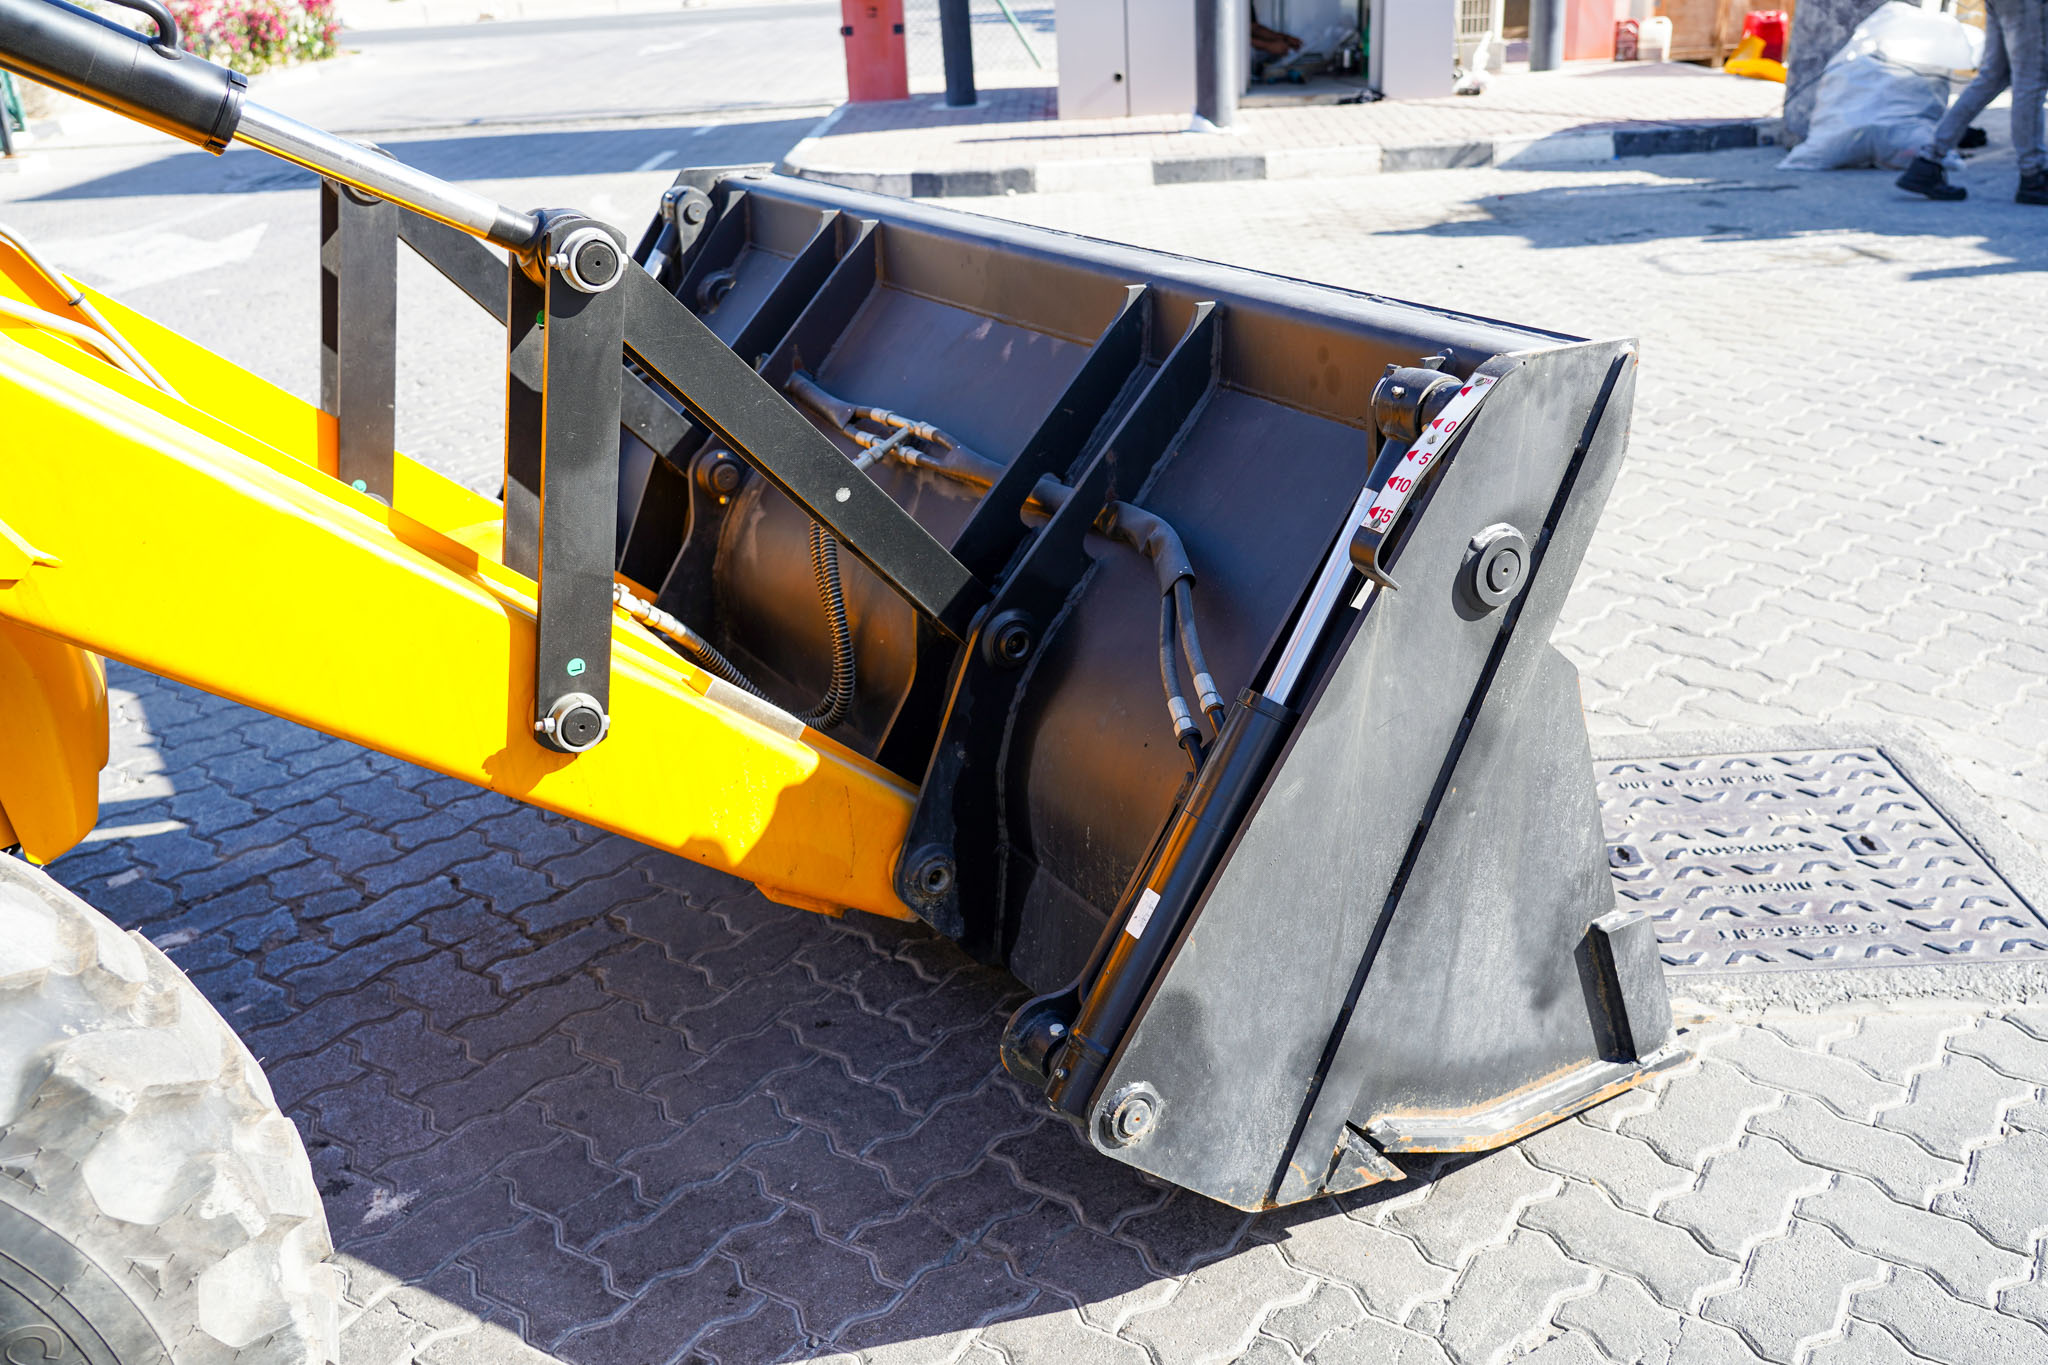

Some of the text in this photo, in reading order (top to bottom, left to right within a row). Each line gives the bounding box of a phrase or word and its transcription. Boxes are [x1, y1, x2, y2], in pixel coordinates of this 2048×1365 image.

[1444, 420, 1457, 433] 0
[1418, 452, 1432, 465] 5
[1396, 478, 1412, 493] 10
[1378, 508, 1394, 523] 15
[1719, 880, 1814, 896] DUCTILE
[1717, 922, 1859, 940] CRESCENT
